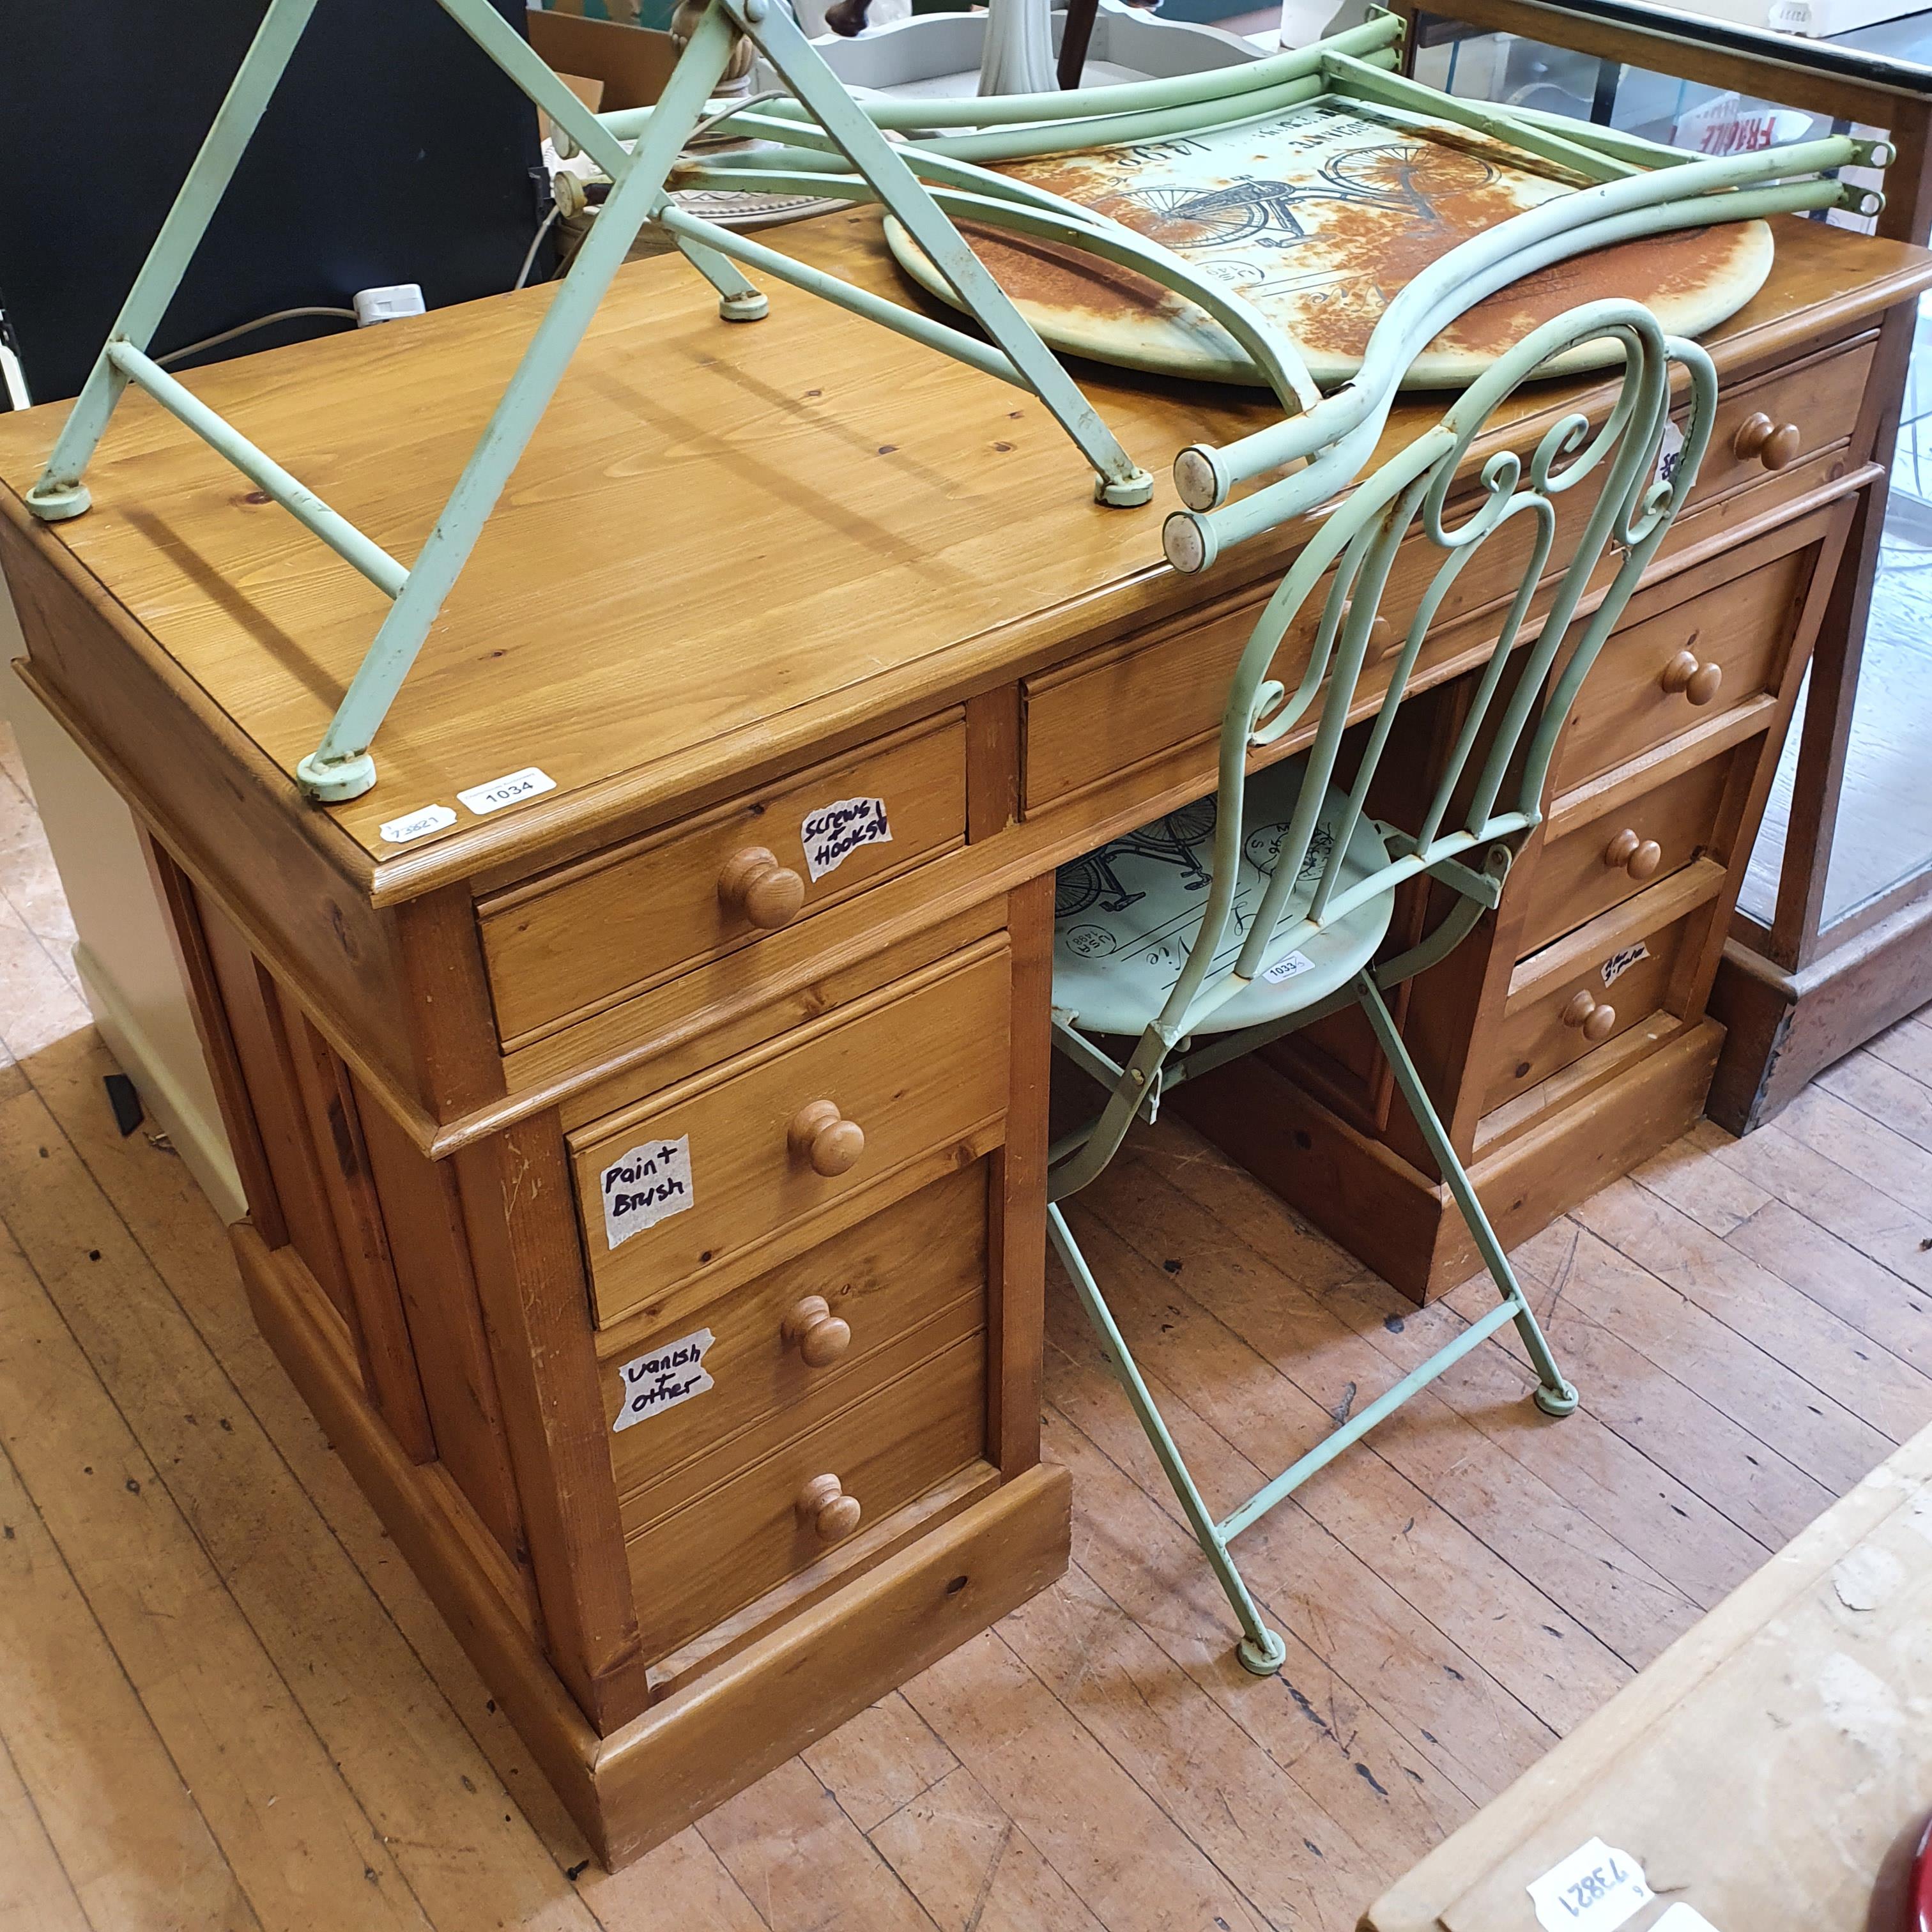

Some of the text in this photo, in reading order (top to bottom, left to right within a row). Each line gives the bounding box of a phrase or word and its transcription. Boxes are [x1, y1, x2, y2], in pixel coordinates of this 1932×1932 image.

[486, 781, 534, 804] 1034
[390, 816, 440, 839] 73821
[1073, 930, 1098, 946] 1498
[1077, 935, 1111, 953] USA
[1269, 962, 1297, 976] 1033
[1558, 1857, 1629, 1917] 73821
